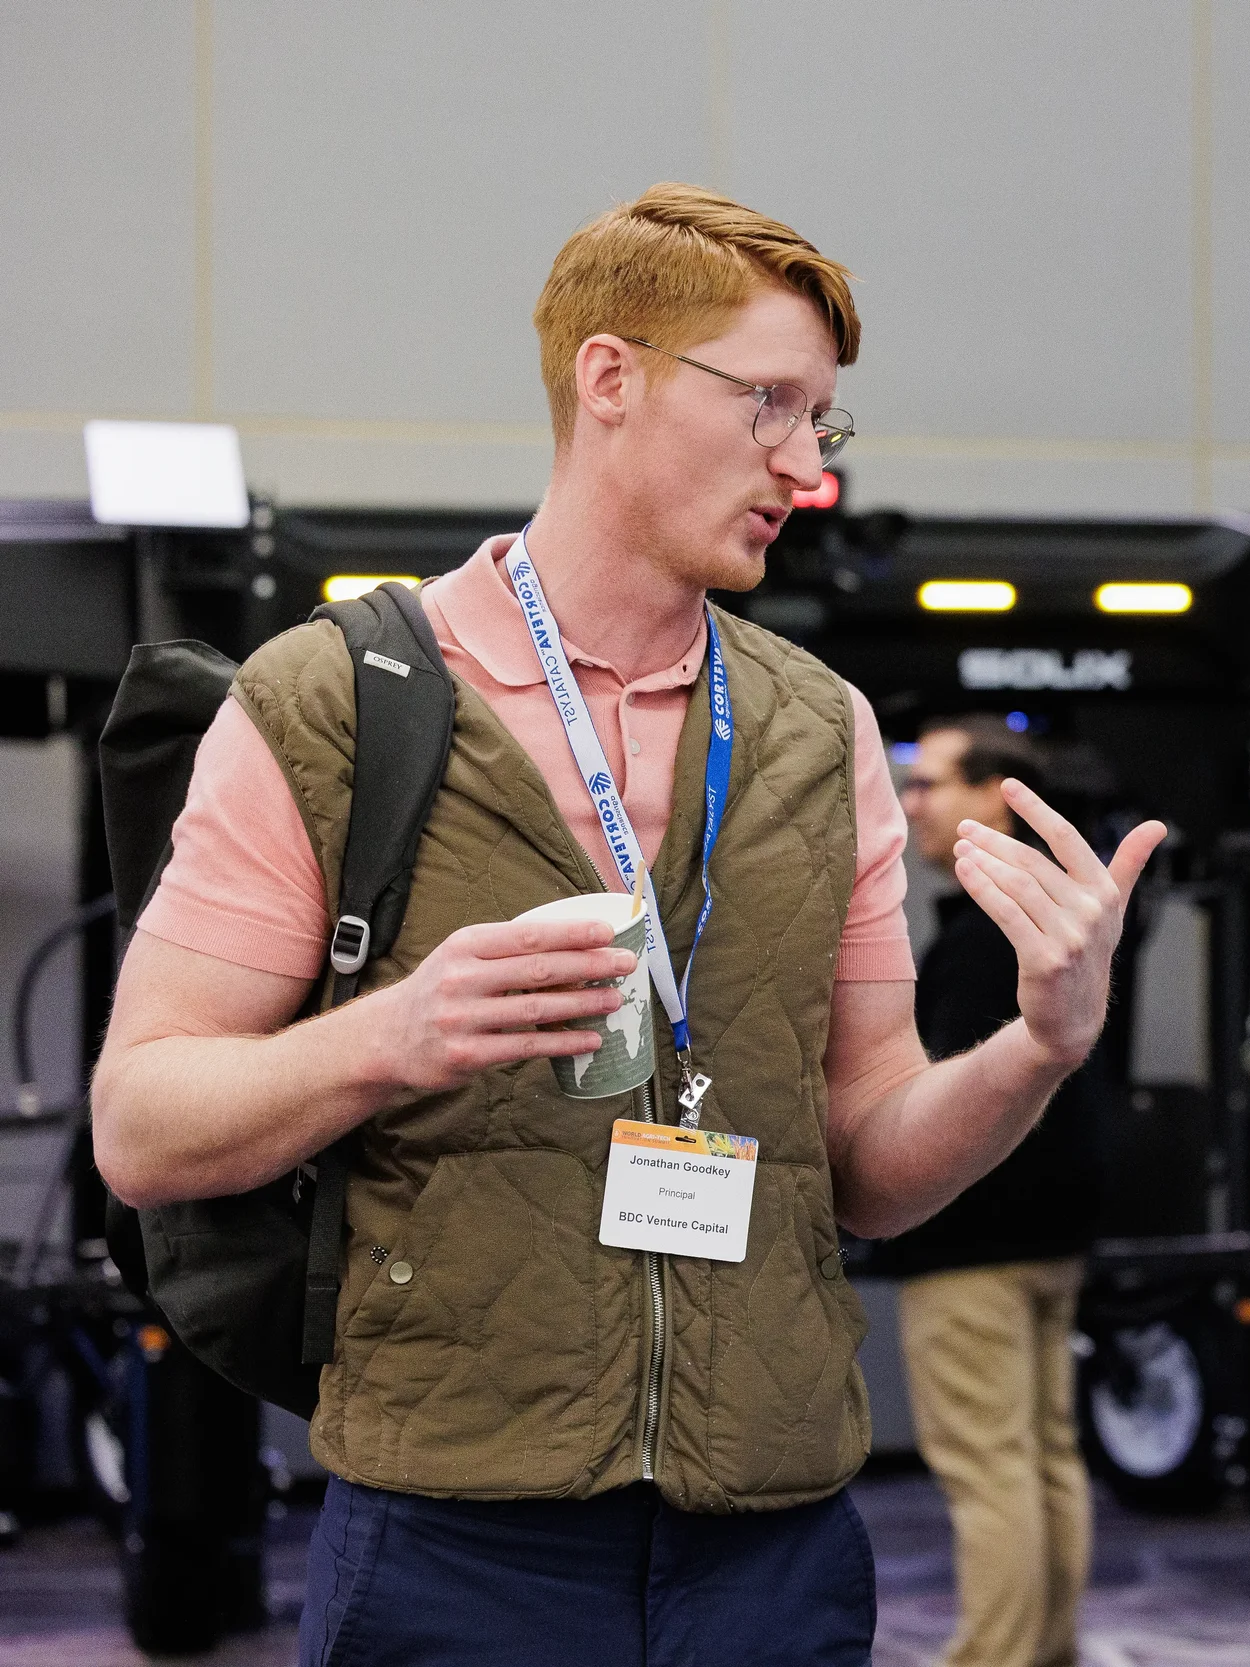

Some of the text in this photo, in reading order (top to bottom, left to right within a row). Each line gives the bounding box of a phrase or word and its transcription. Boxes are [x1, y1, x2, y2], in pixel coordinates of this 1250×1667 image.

[374, 657, 402, 670] OSPREY
[630, 1155, 731, 1178] Jonathan Goodkey
[658, 1188, 696, 1200] Principal
[619, 1211, 728, 1234] BDC Venture Capital
